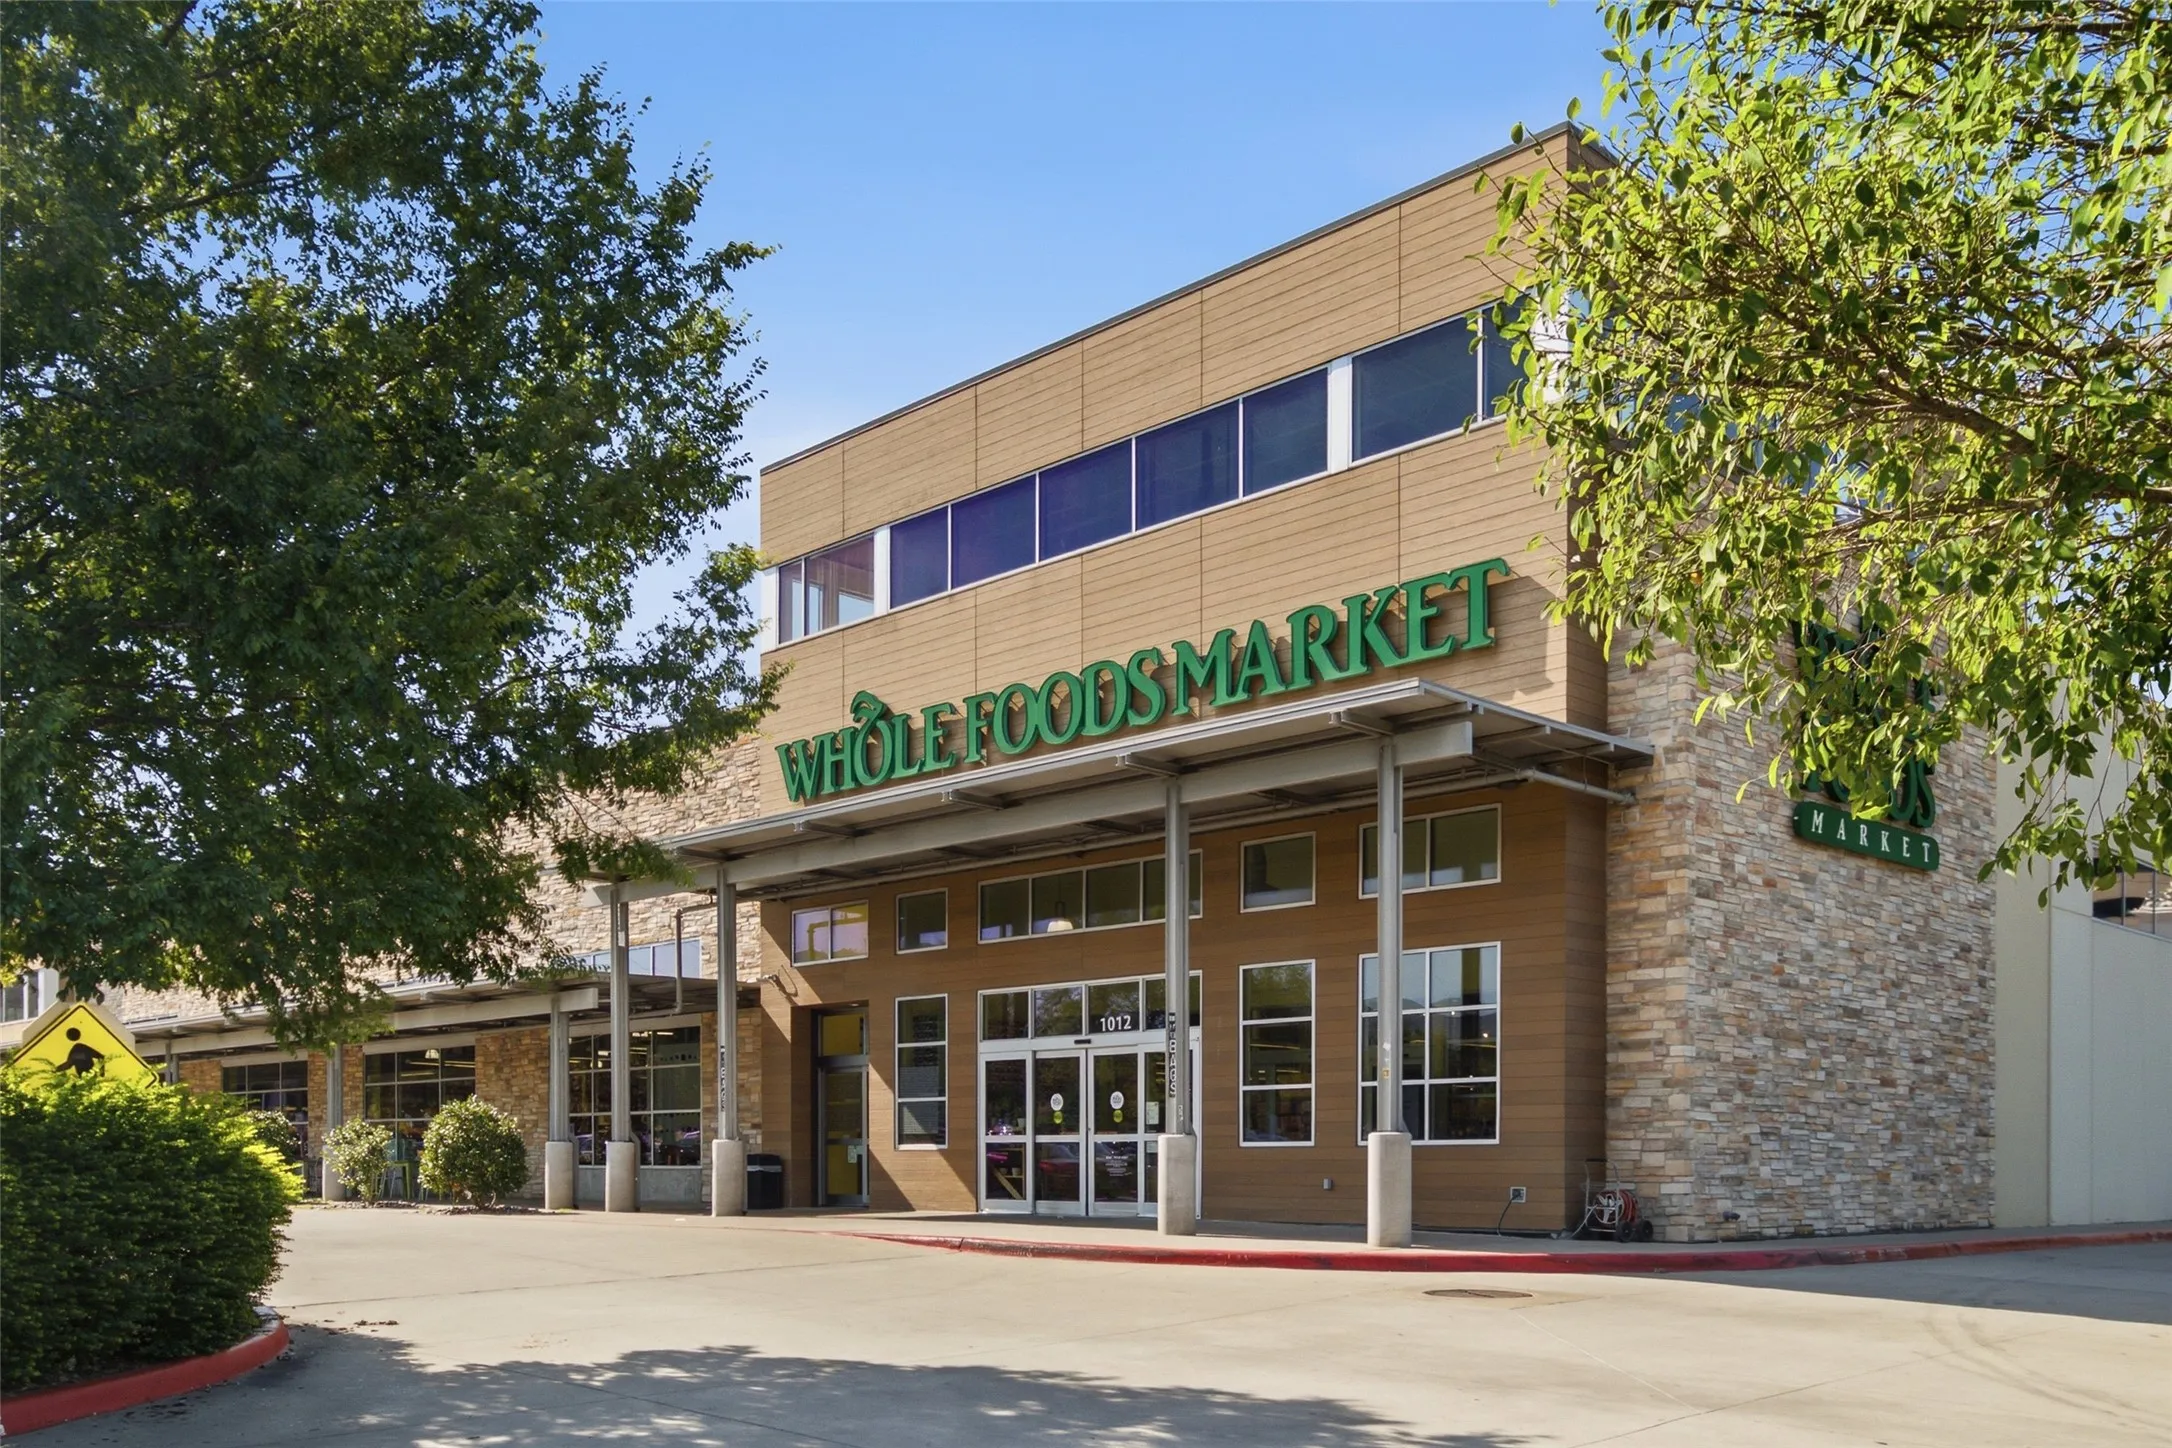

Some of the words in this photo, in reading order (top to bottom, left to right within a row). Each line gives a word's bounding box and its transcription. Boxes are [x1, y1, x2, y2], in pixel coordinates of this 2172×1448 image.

[775, 690, 957, 802] WHOLE
[963, 647, 1166, 764] FOODS
[1171, 557, 1511, 716] MARKET
[1811, 809, 1931, 863] MARKET
[1100, 1014, 1132, 1032] 1012
